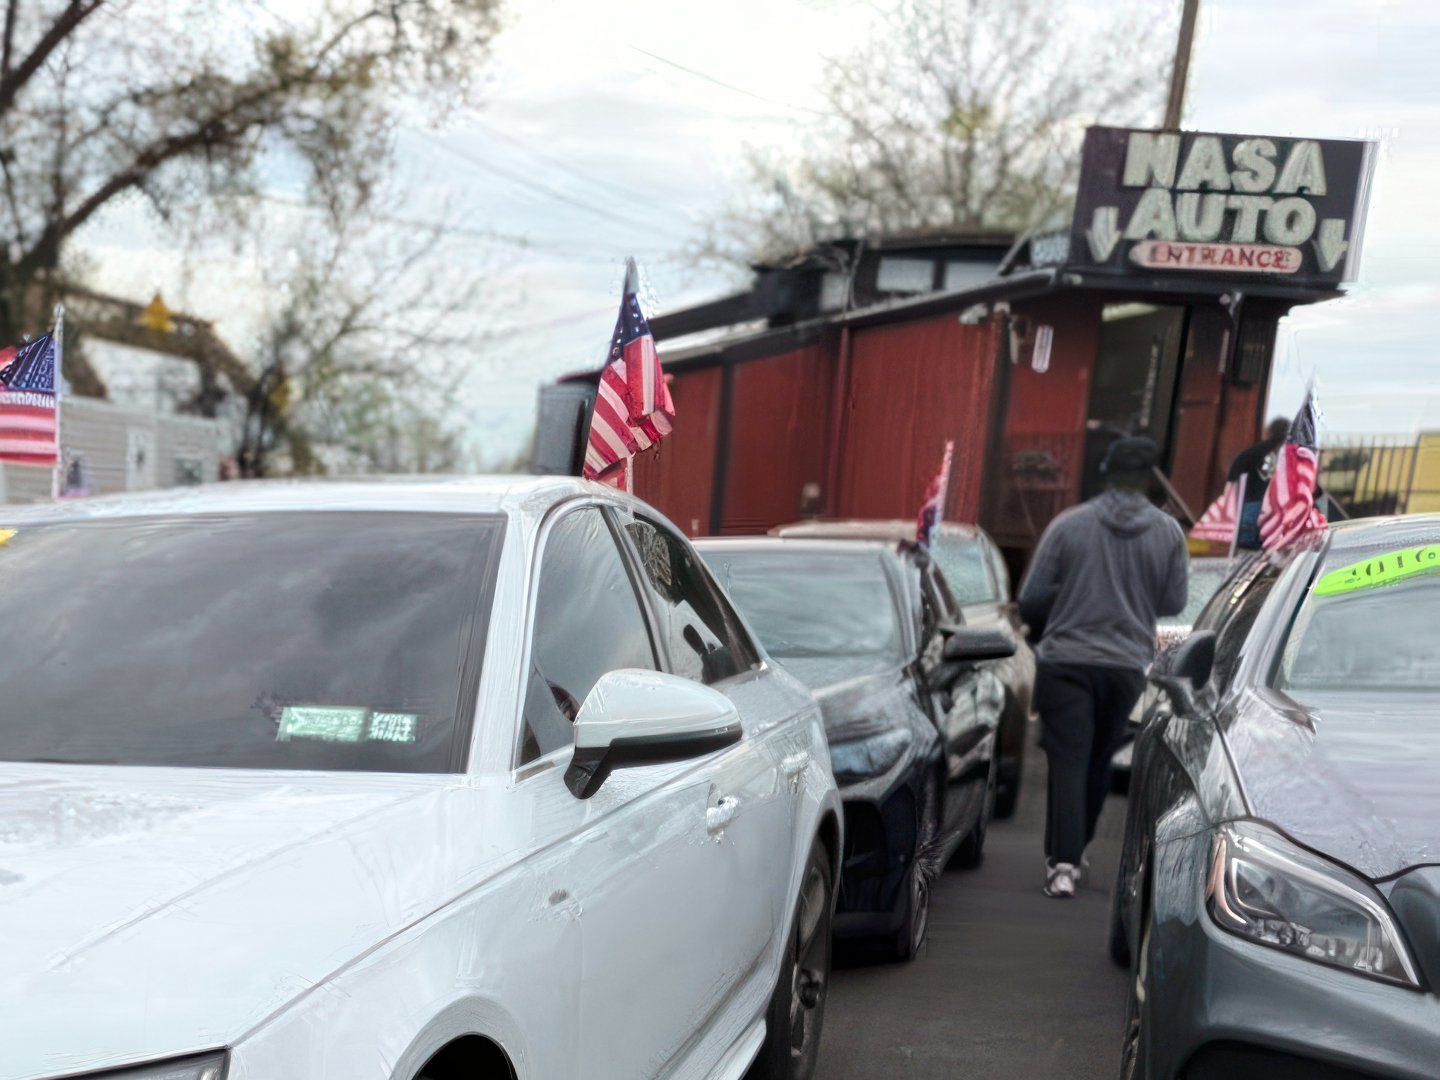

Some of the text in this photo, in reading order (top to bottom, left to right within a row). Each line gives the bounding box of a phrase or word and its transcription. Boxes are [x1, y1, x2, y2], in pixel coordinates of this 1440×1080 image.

[1122, 131, 1328, 196] NASA
[1123, 187, 1317, 246] AUTO
[1150, 244, 1290, 270] ENTRANCE
